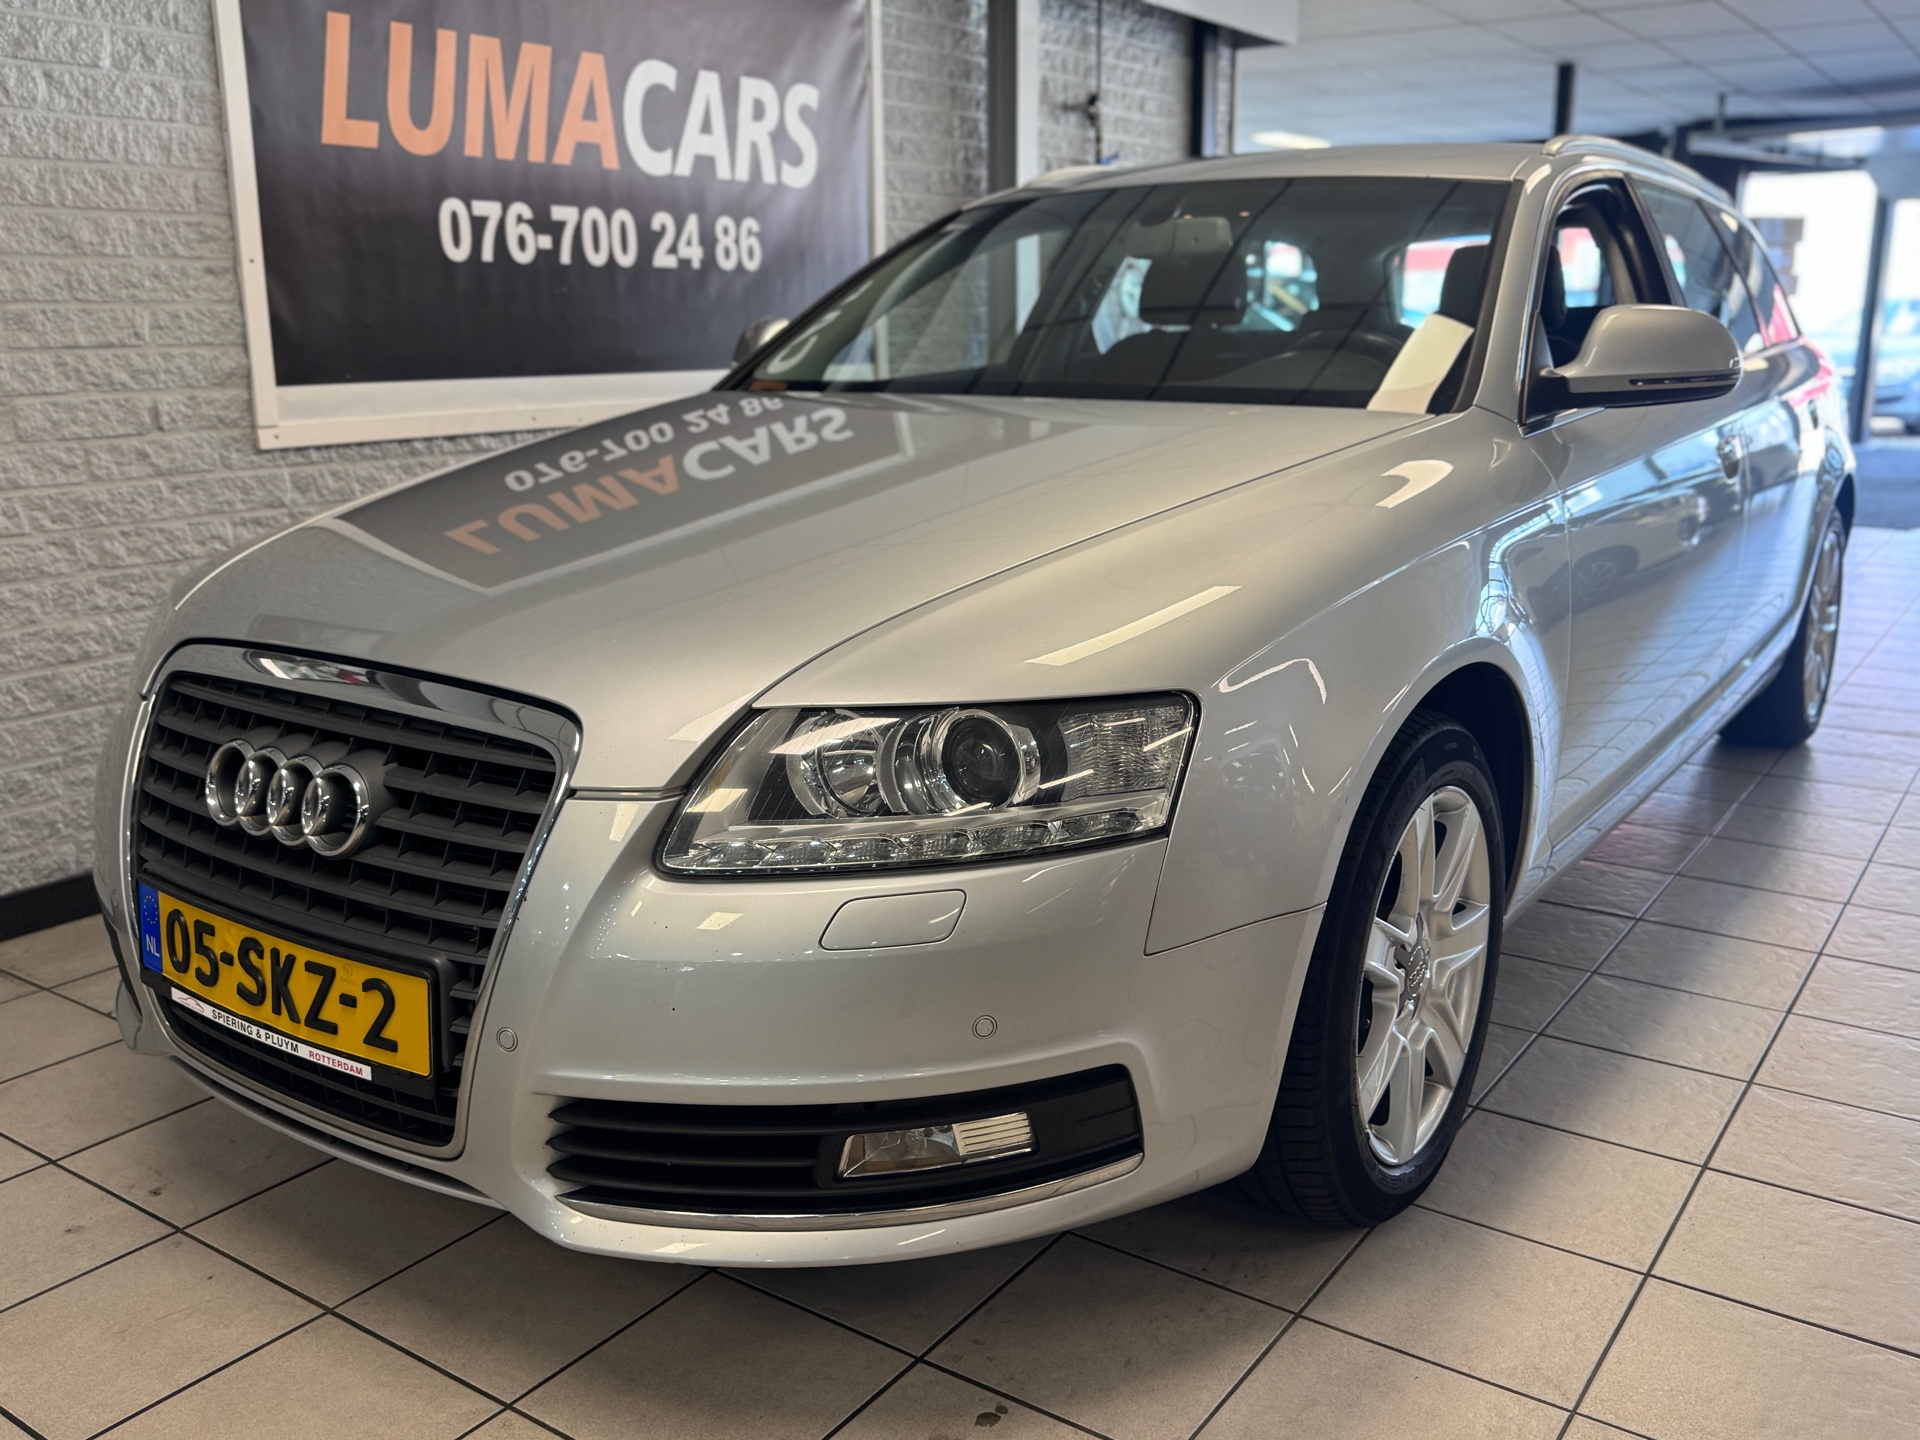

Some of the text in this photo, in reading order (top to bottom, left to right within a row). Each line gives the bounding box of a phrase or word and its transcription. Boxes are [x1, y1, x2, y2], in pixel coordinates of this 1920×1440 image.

[438, 197, 762, 271] 076-700 24 86
[145, 934, 160, 957] NL
[166, 908, 398, 1053] 05-SKZ-2
[212, 1009, 364, 1076] SPIERING & PLUYM ROTTERDAM
